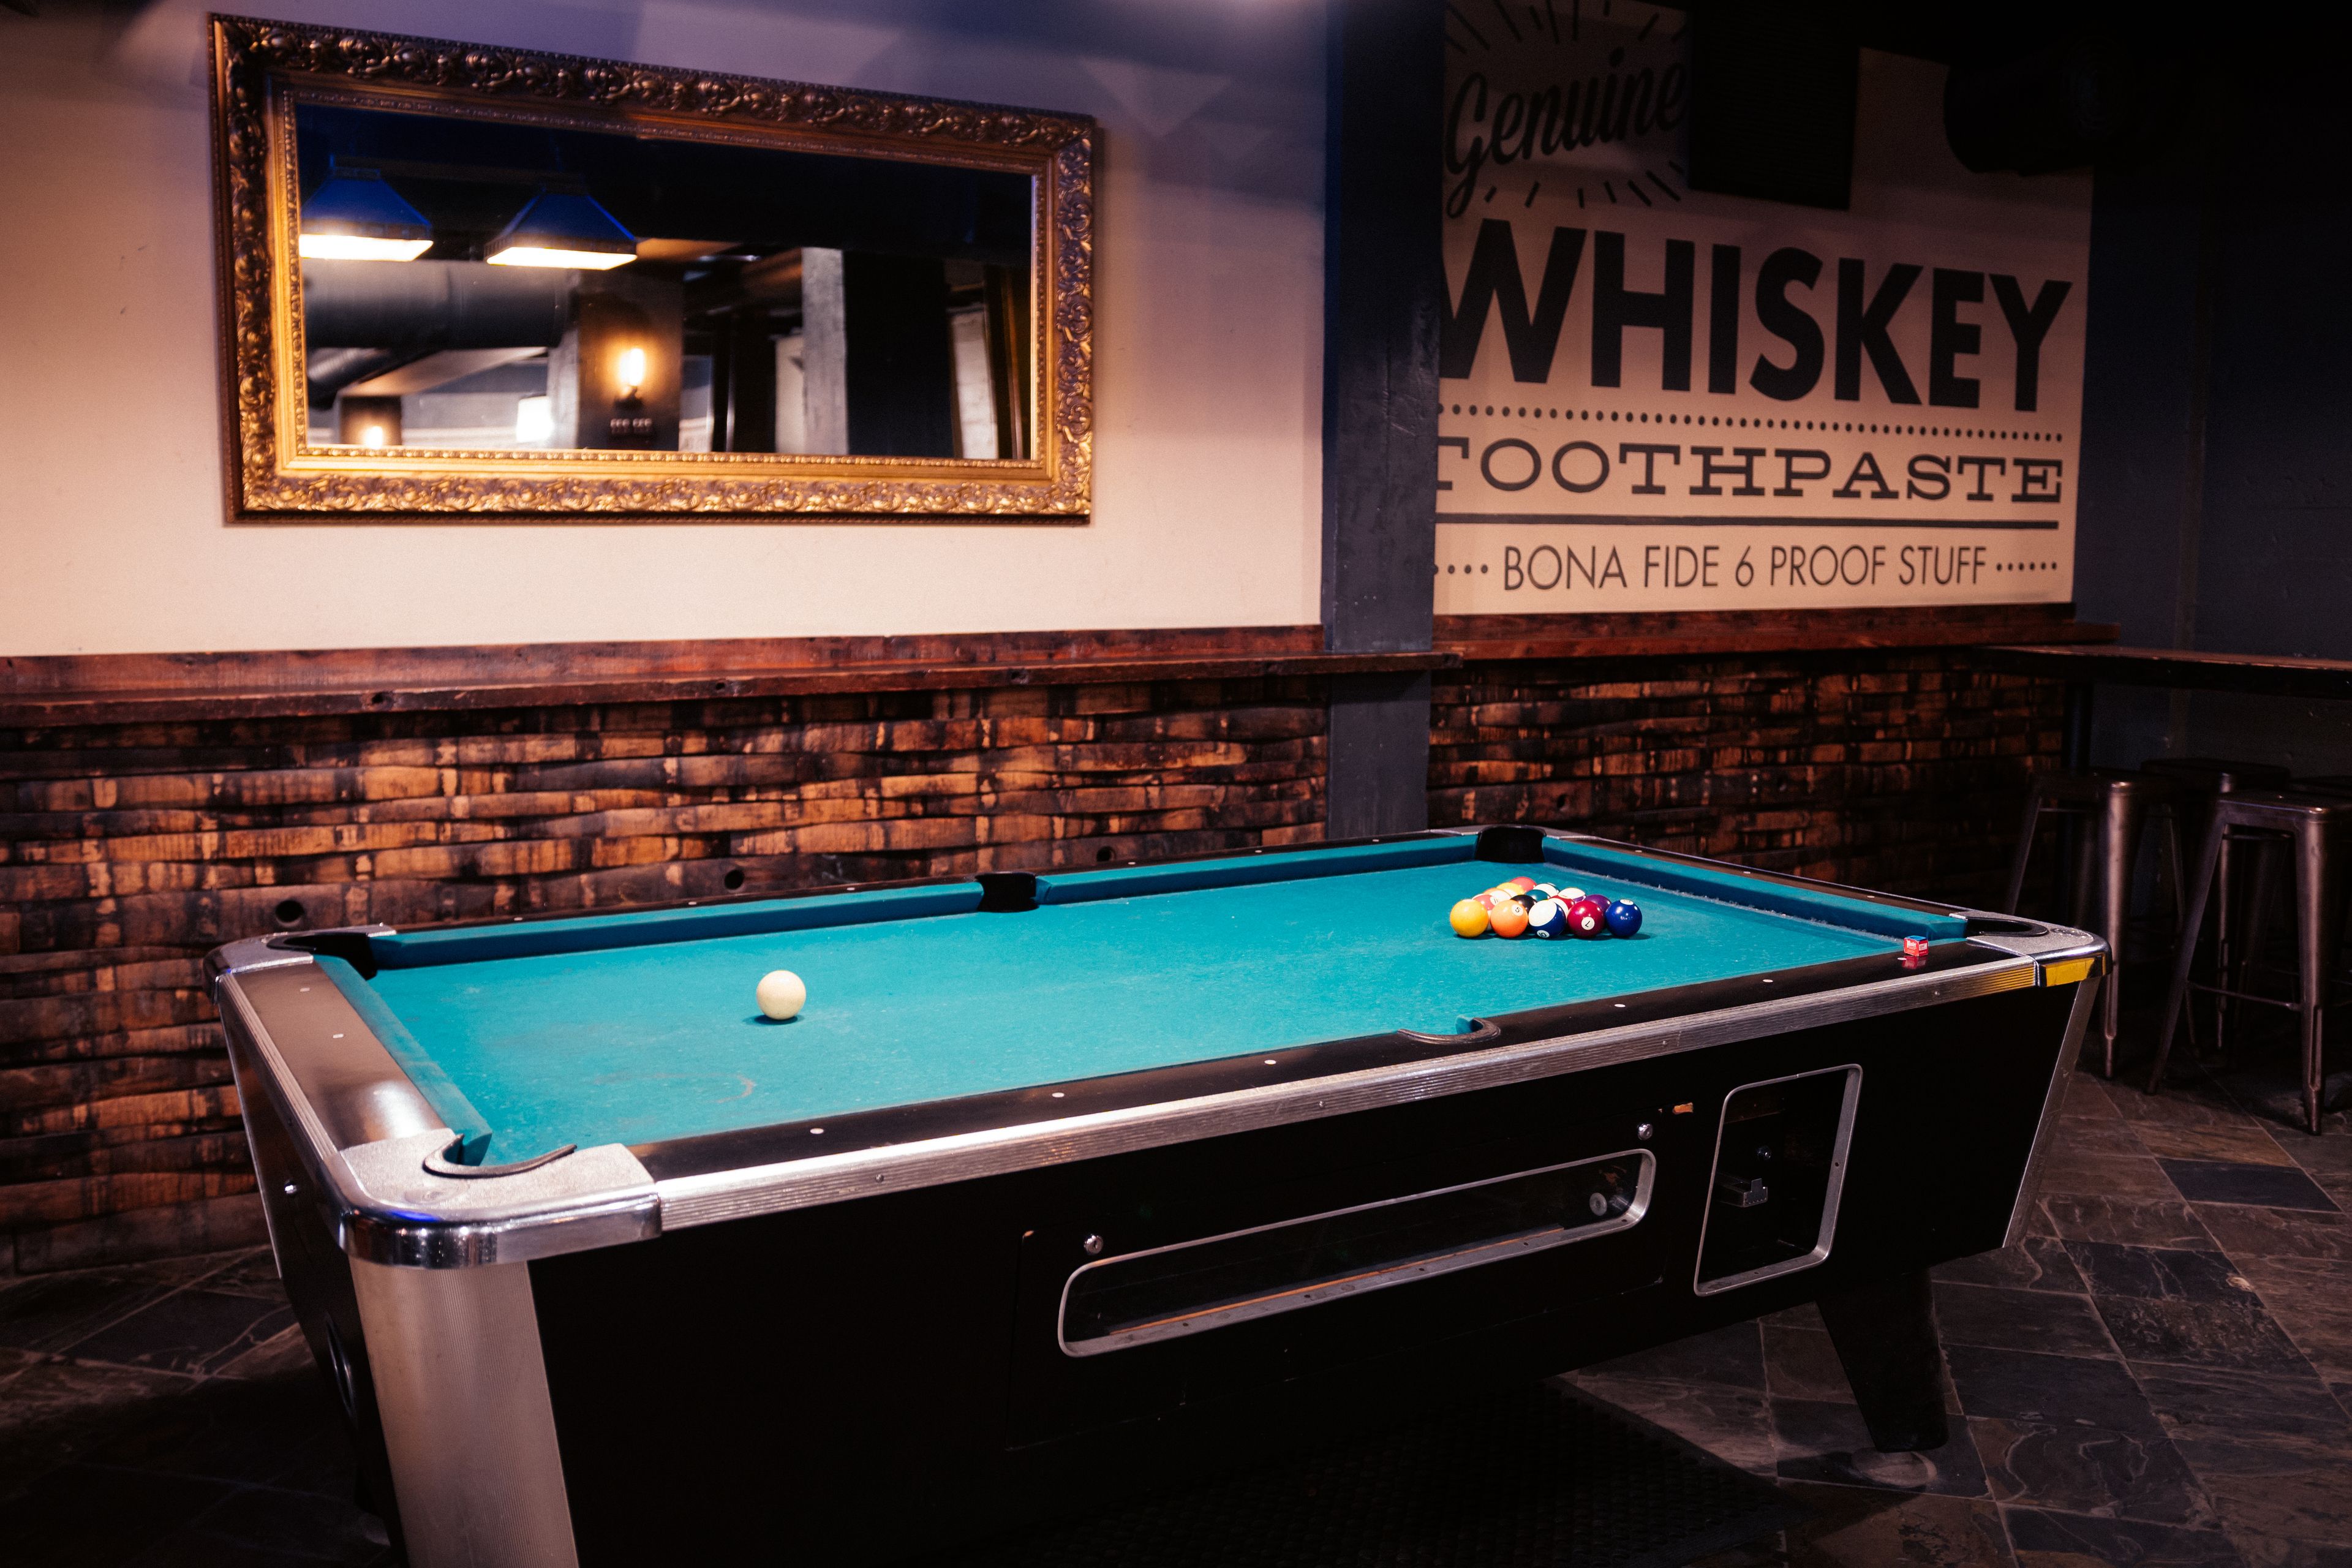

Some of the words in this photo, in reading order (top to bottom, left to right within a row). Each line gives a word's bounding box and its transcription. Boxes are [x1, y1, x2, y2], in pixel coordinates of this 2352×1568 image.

[1445, 47, 1686, 219] Genuine
[1438, 217, 2073, 412] WHISKEY
[1504, 545, 1627, 590] BONA
[1645, 546, 1719, 587] FIDE
[1735, 546, 1754, 587] 6
[1771, 545, 1885, 586] PROOF
[1899, 546, 1986, 585] STUFF
